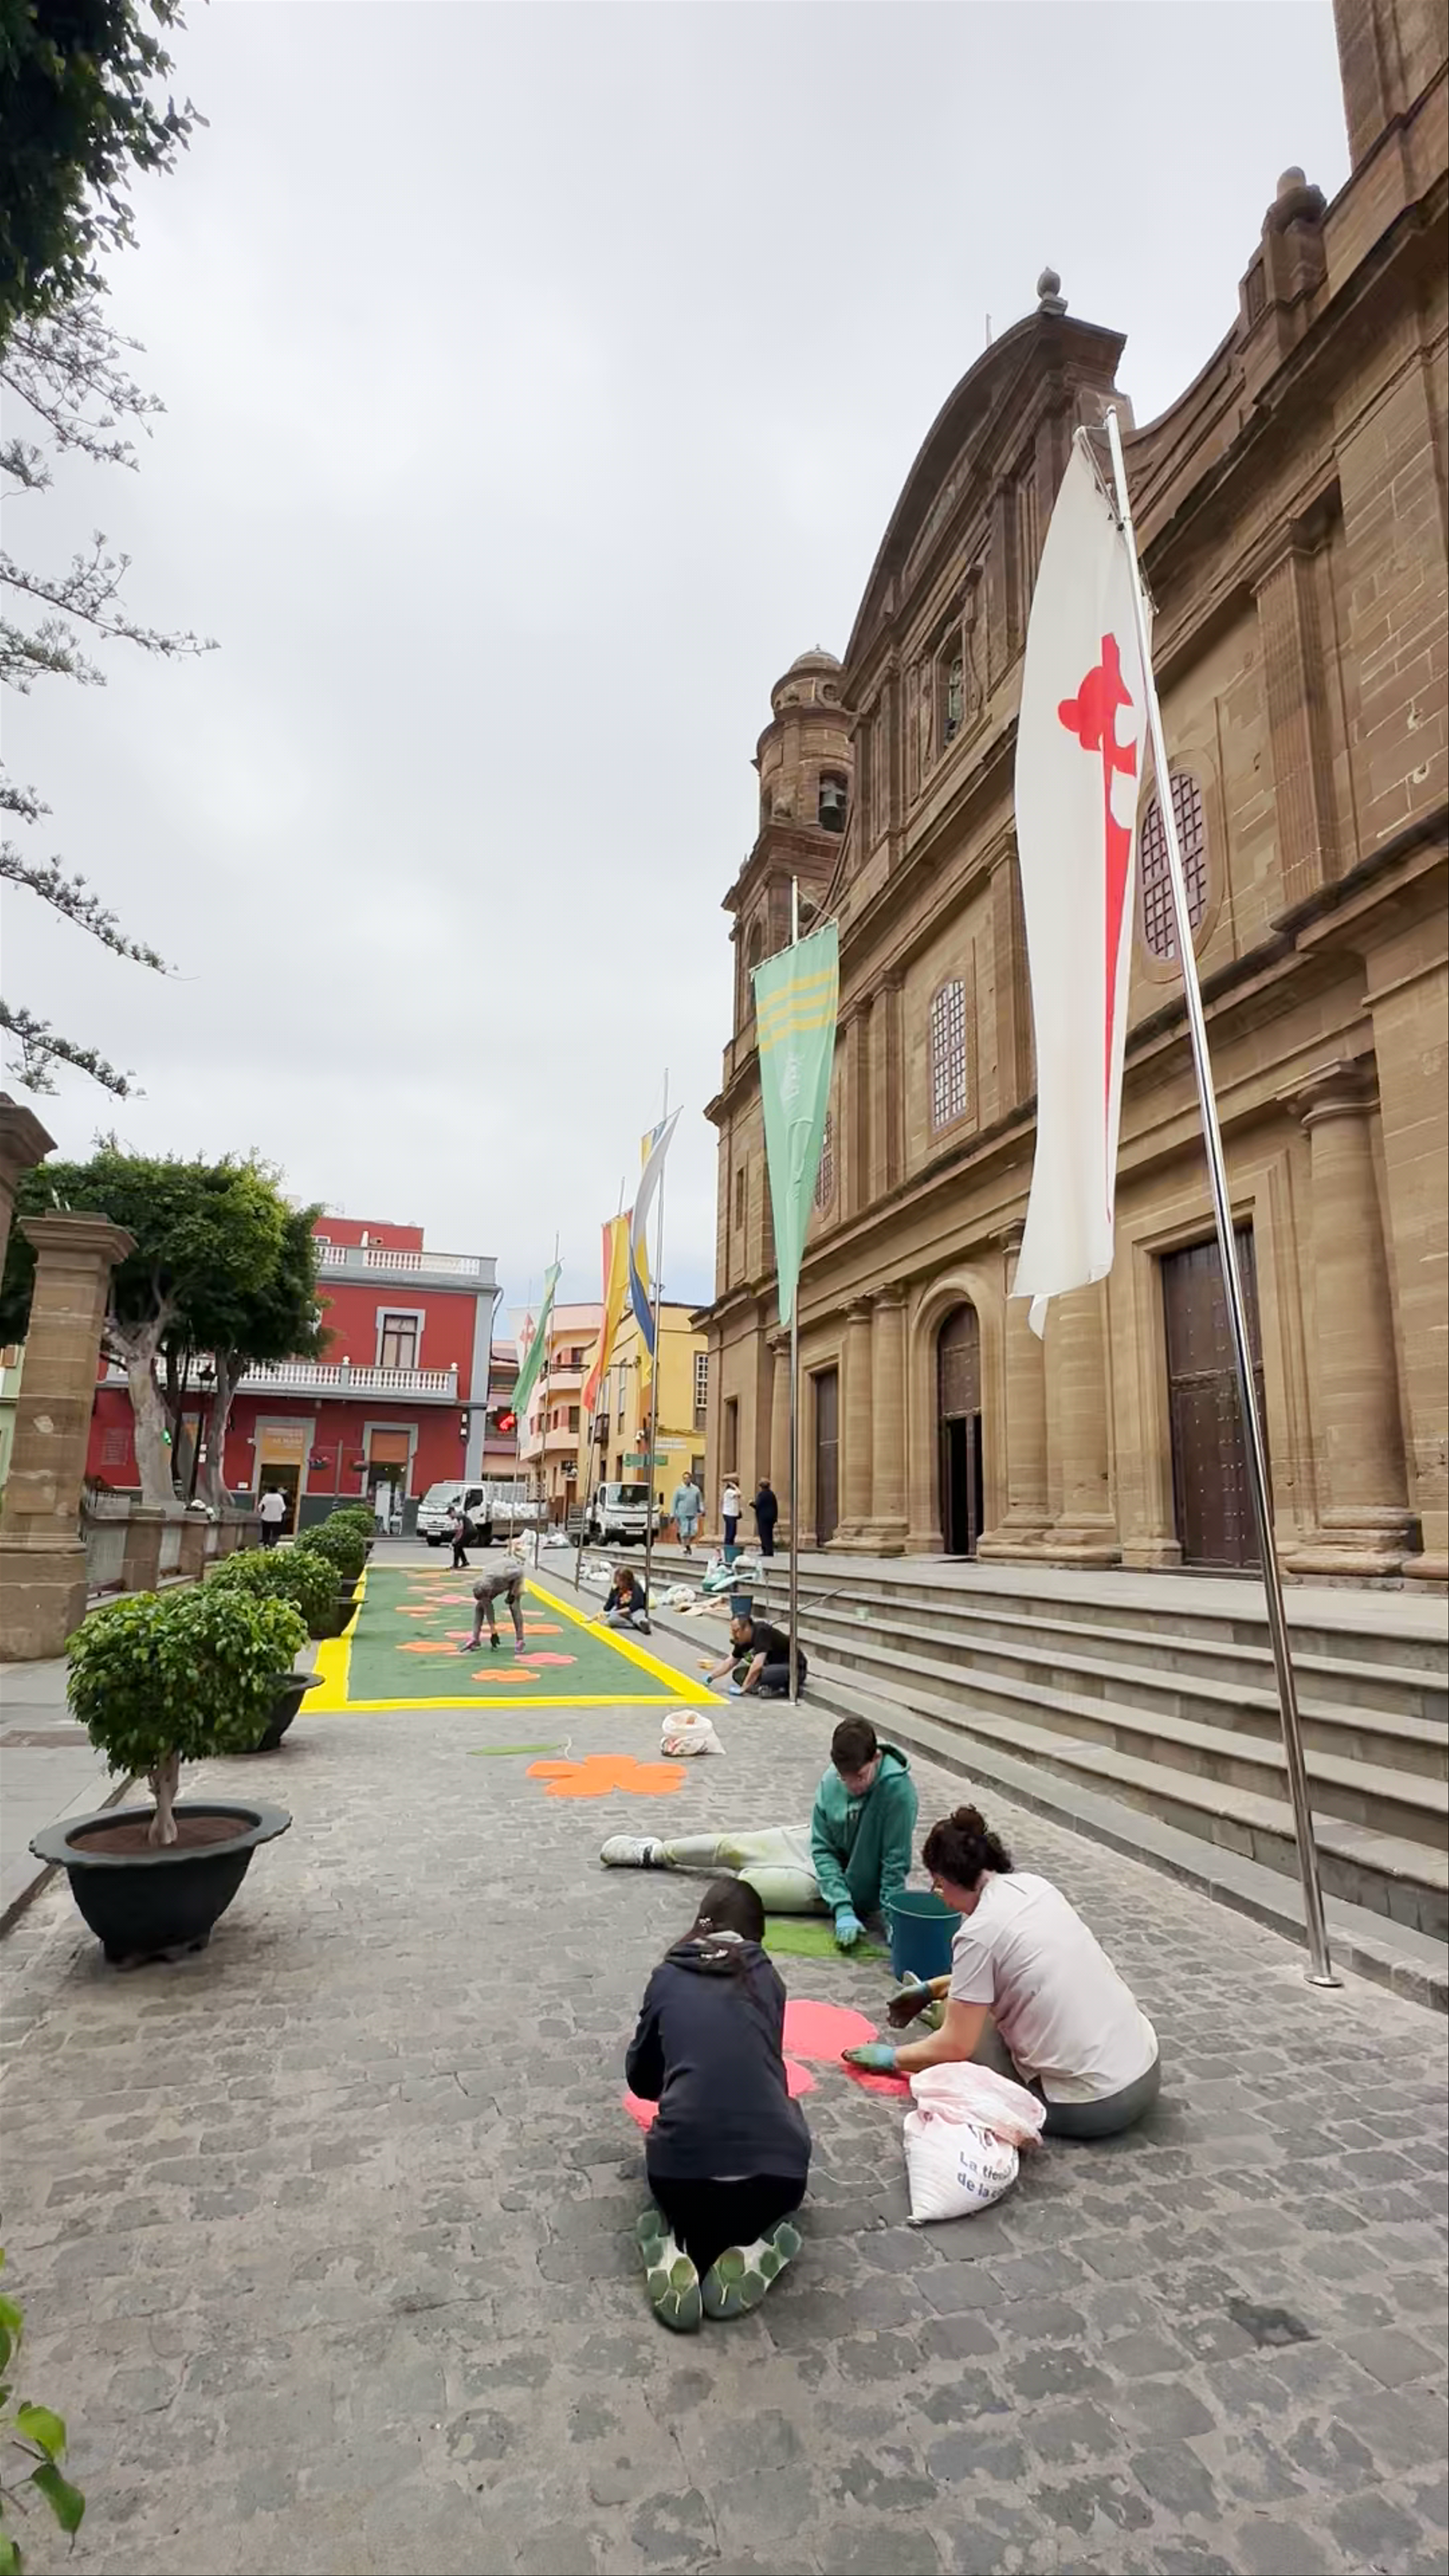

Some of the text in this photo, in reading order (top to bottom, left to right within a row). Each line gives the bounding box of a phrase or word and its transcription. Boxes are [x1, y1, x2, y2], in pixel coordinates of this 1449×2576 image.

[960, 2151, 977, 2174] La
[957, 2172, 975, 2192] de
[978, 2183, 989, 2198] la
